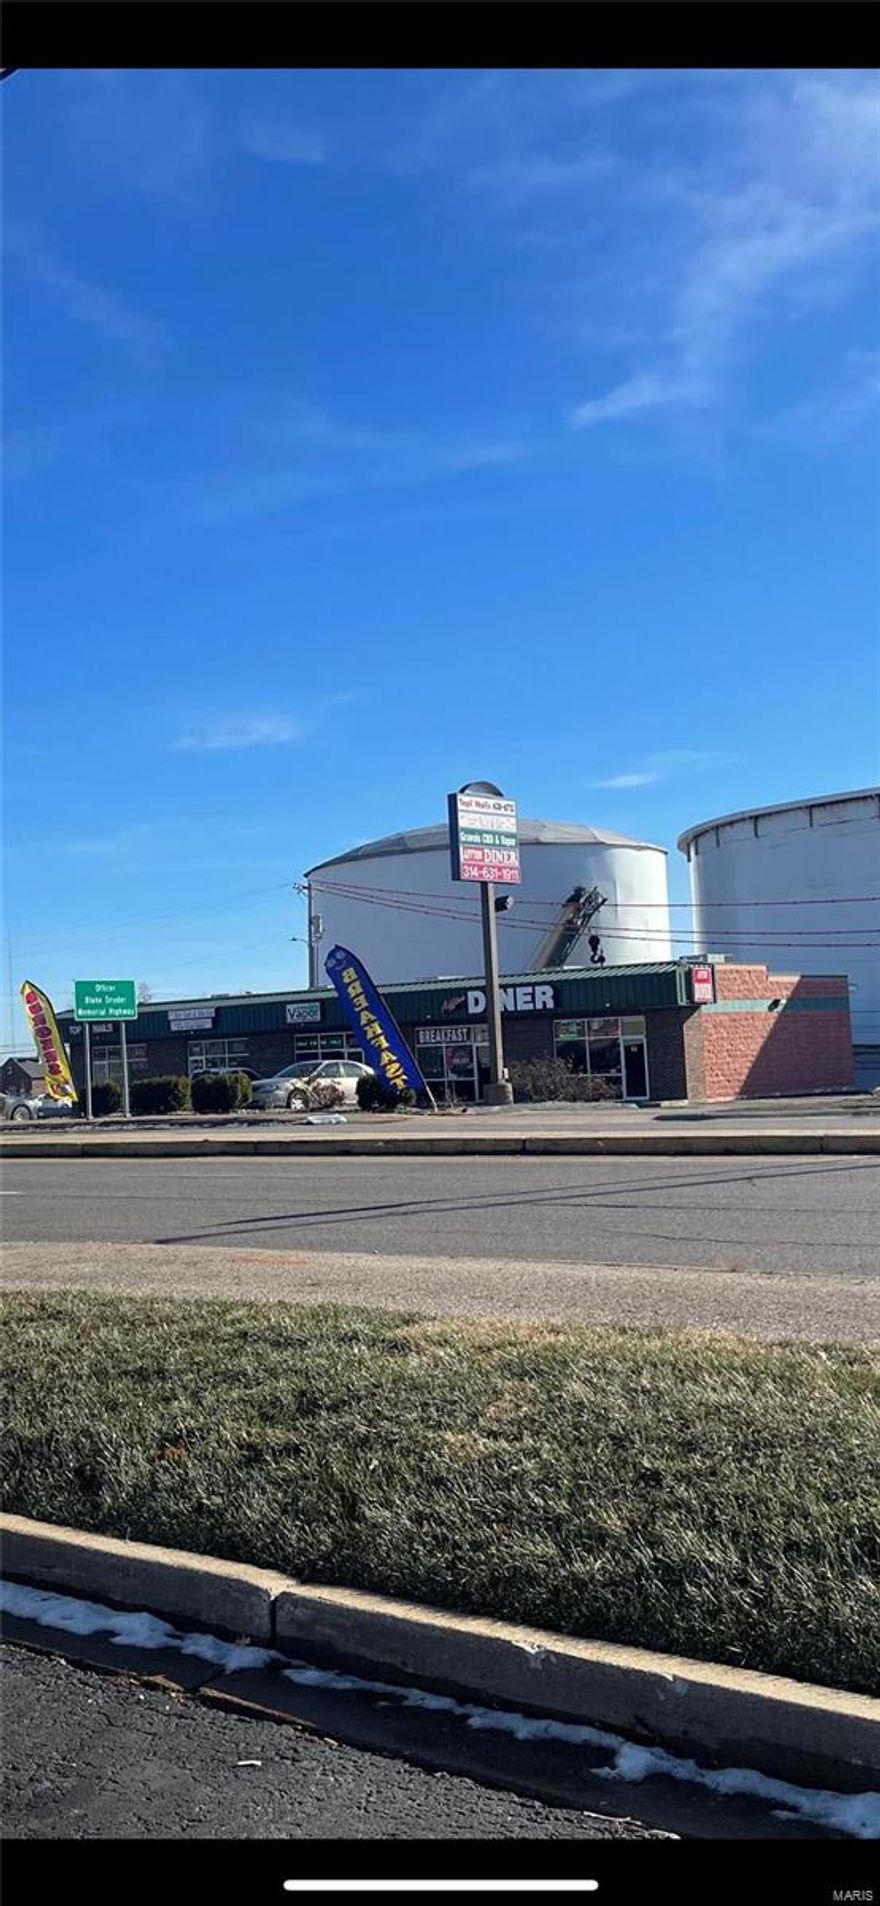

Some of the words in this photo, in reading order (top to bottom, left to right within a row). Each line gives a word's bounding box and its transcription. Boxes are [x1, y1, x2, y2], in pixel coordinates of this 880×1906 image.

[484, 849, 517, 864] DINER
[467, 985, 555, 1014] DNER
[78, 1008, 106, 1016] Memorial
[109, 1008, 135, 1017] Highway
[419, 1028, 468, 1043] BREAKFAST
